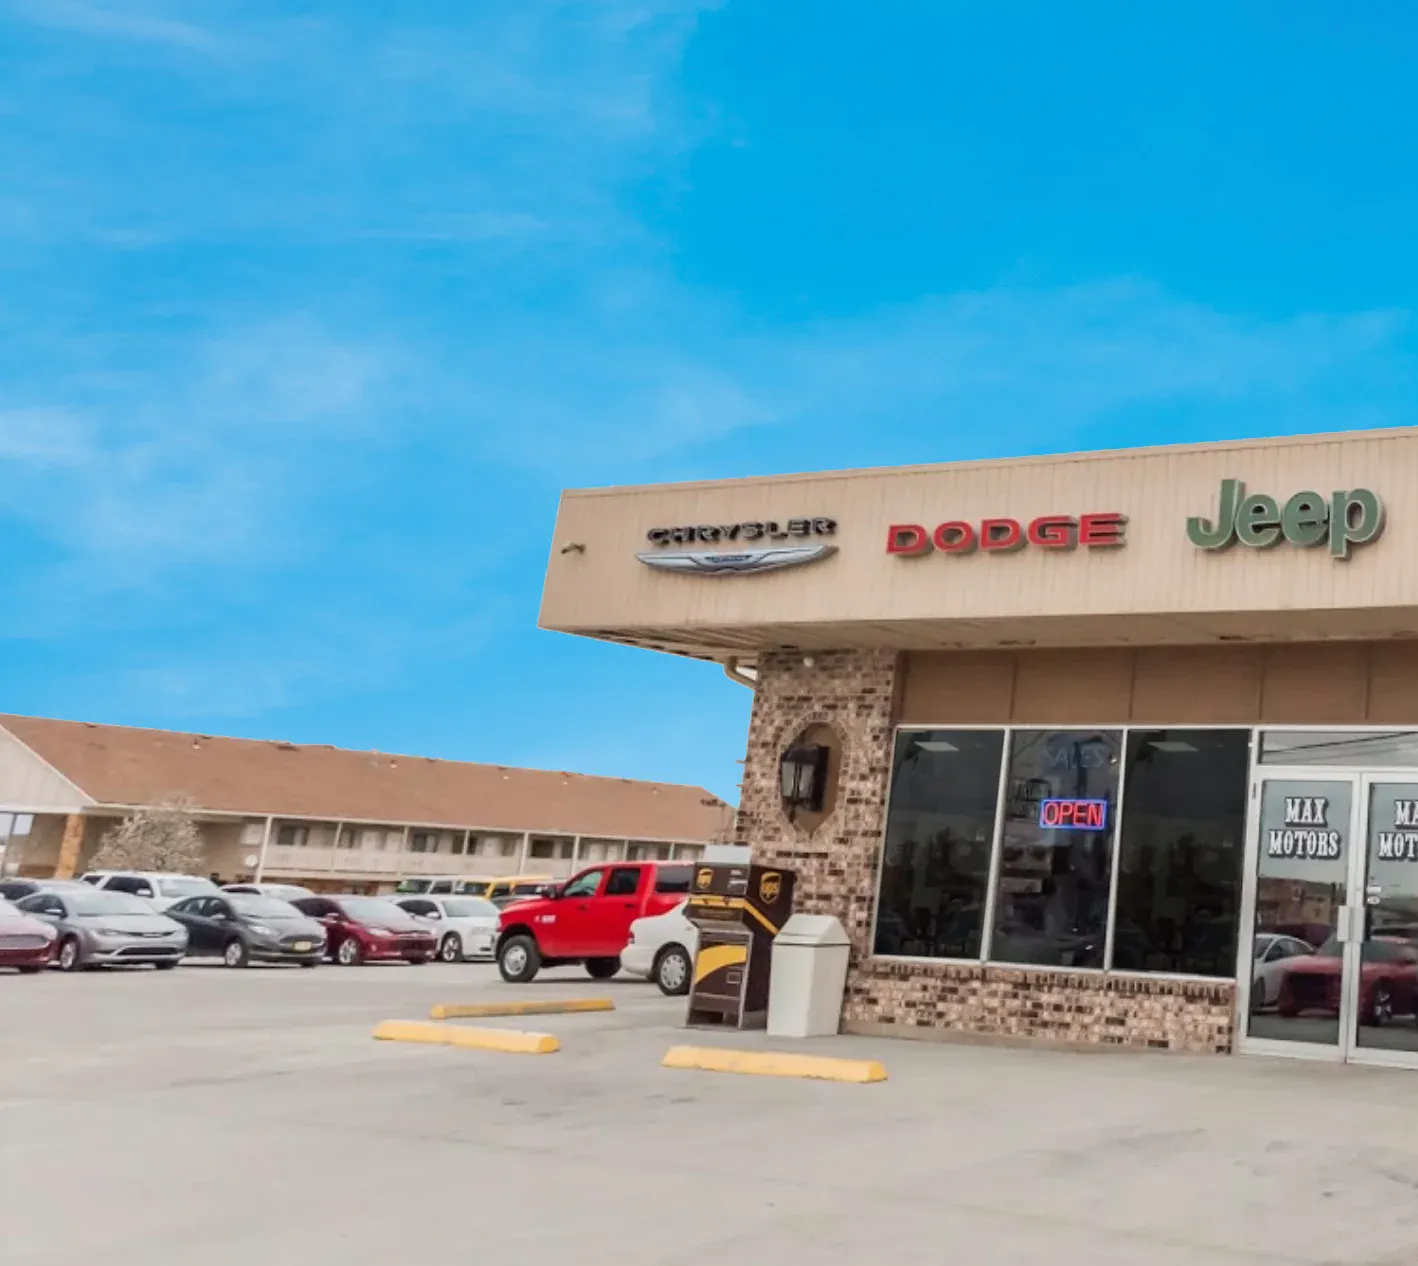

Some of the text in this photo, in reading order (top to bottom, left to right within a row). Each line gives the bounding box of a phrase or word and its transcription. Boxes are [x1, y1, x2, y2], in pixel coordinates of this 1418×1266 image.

[647, 517, 838, 545] CHRYSLER
[886, 513, 1128, 556] DODGE
[1186, 479, 1387, 560] Jeep
[1043, 802, 1104, 827] OPEN
[1284, 797, 1329, 827] MAX
[1268, 829, 1342, 860] MOTORS
